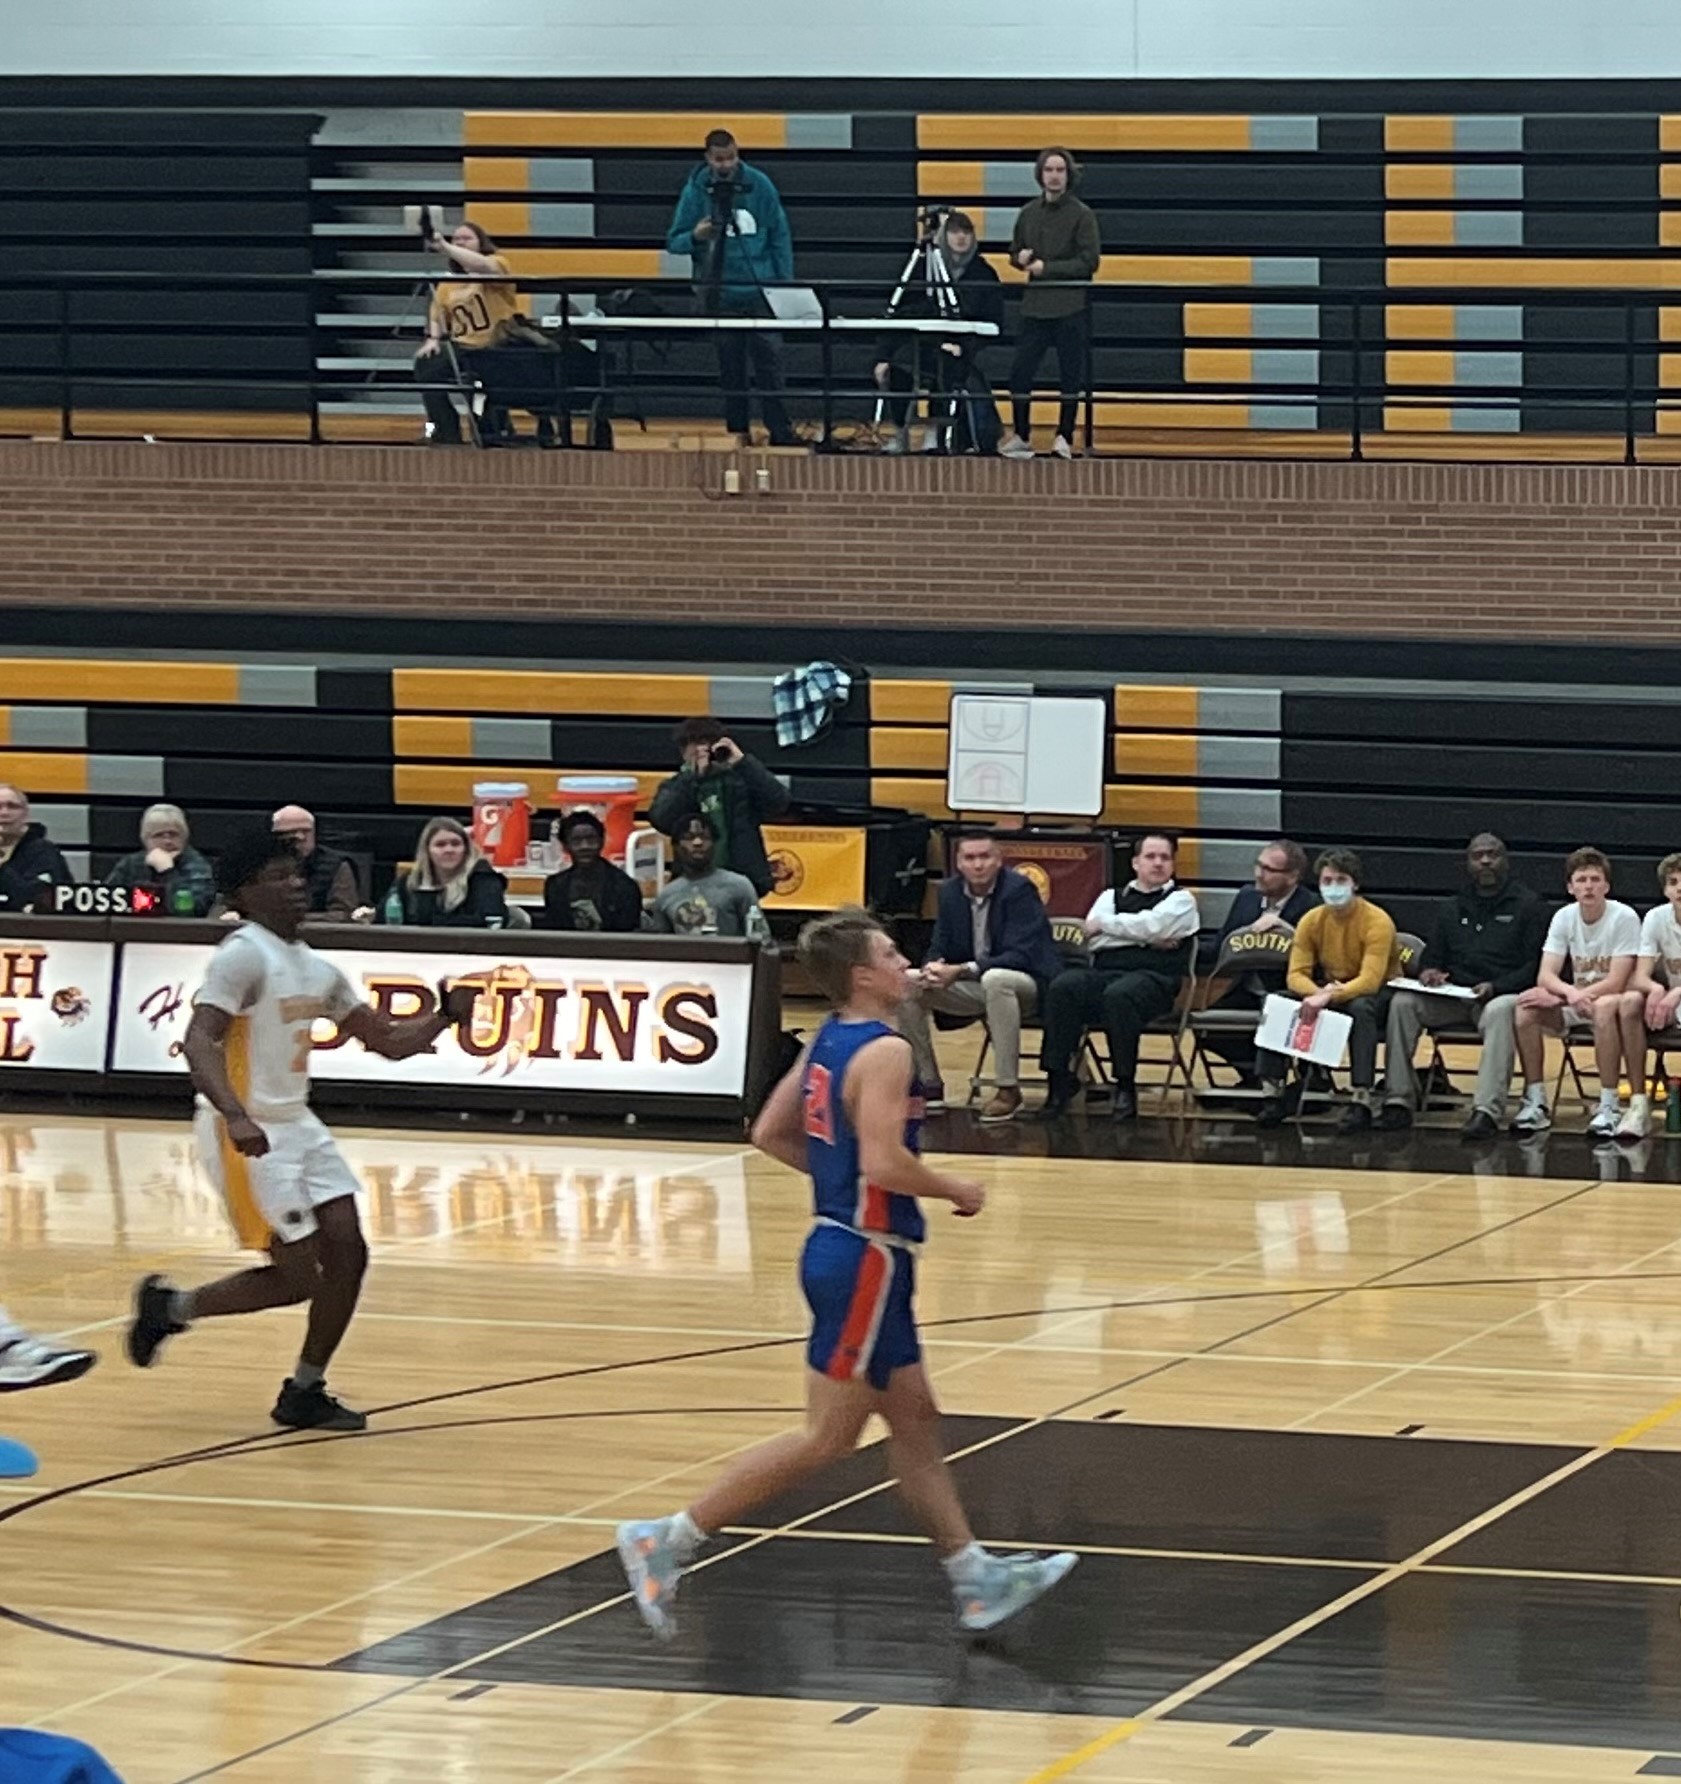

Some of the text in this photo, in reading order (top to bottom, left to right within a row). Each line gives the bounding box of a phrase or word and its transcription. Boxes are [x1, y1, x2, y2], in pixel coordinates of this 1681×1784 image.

[480, 804, 500, 825] G
[1053, 923, 1085, 946] UTH
[1229, 933, 1291, 953] SOUTH
[303, 974, 720, 1067] RUINS
